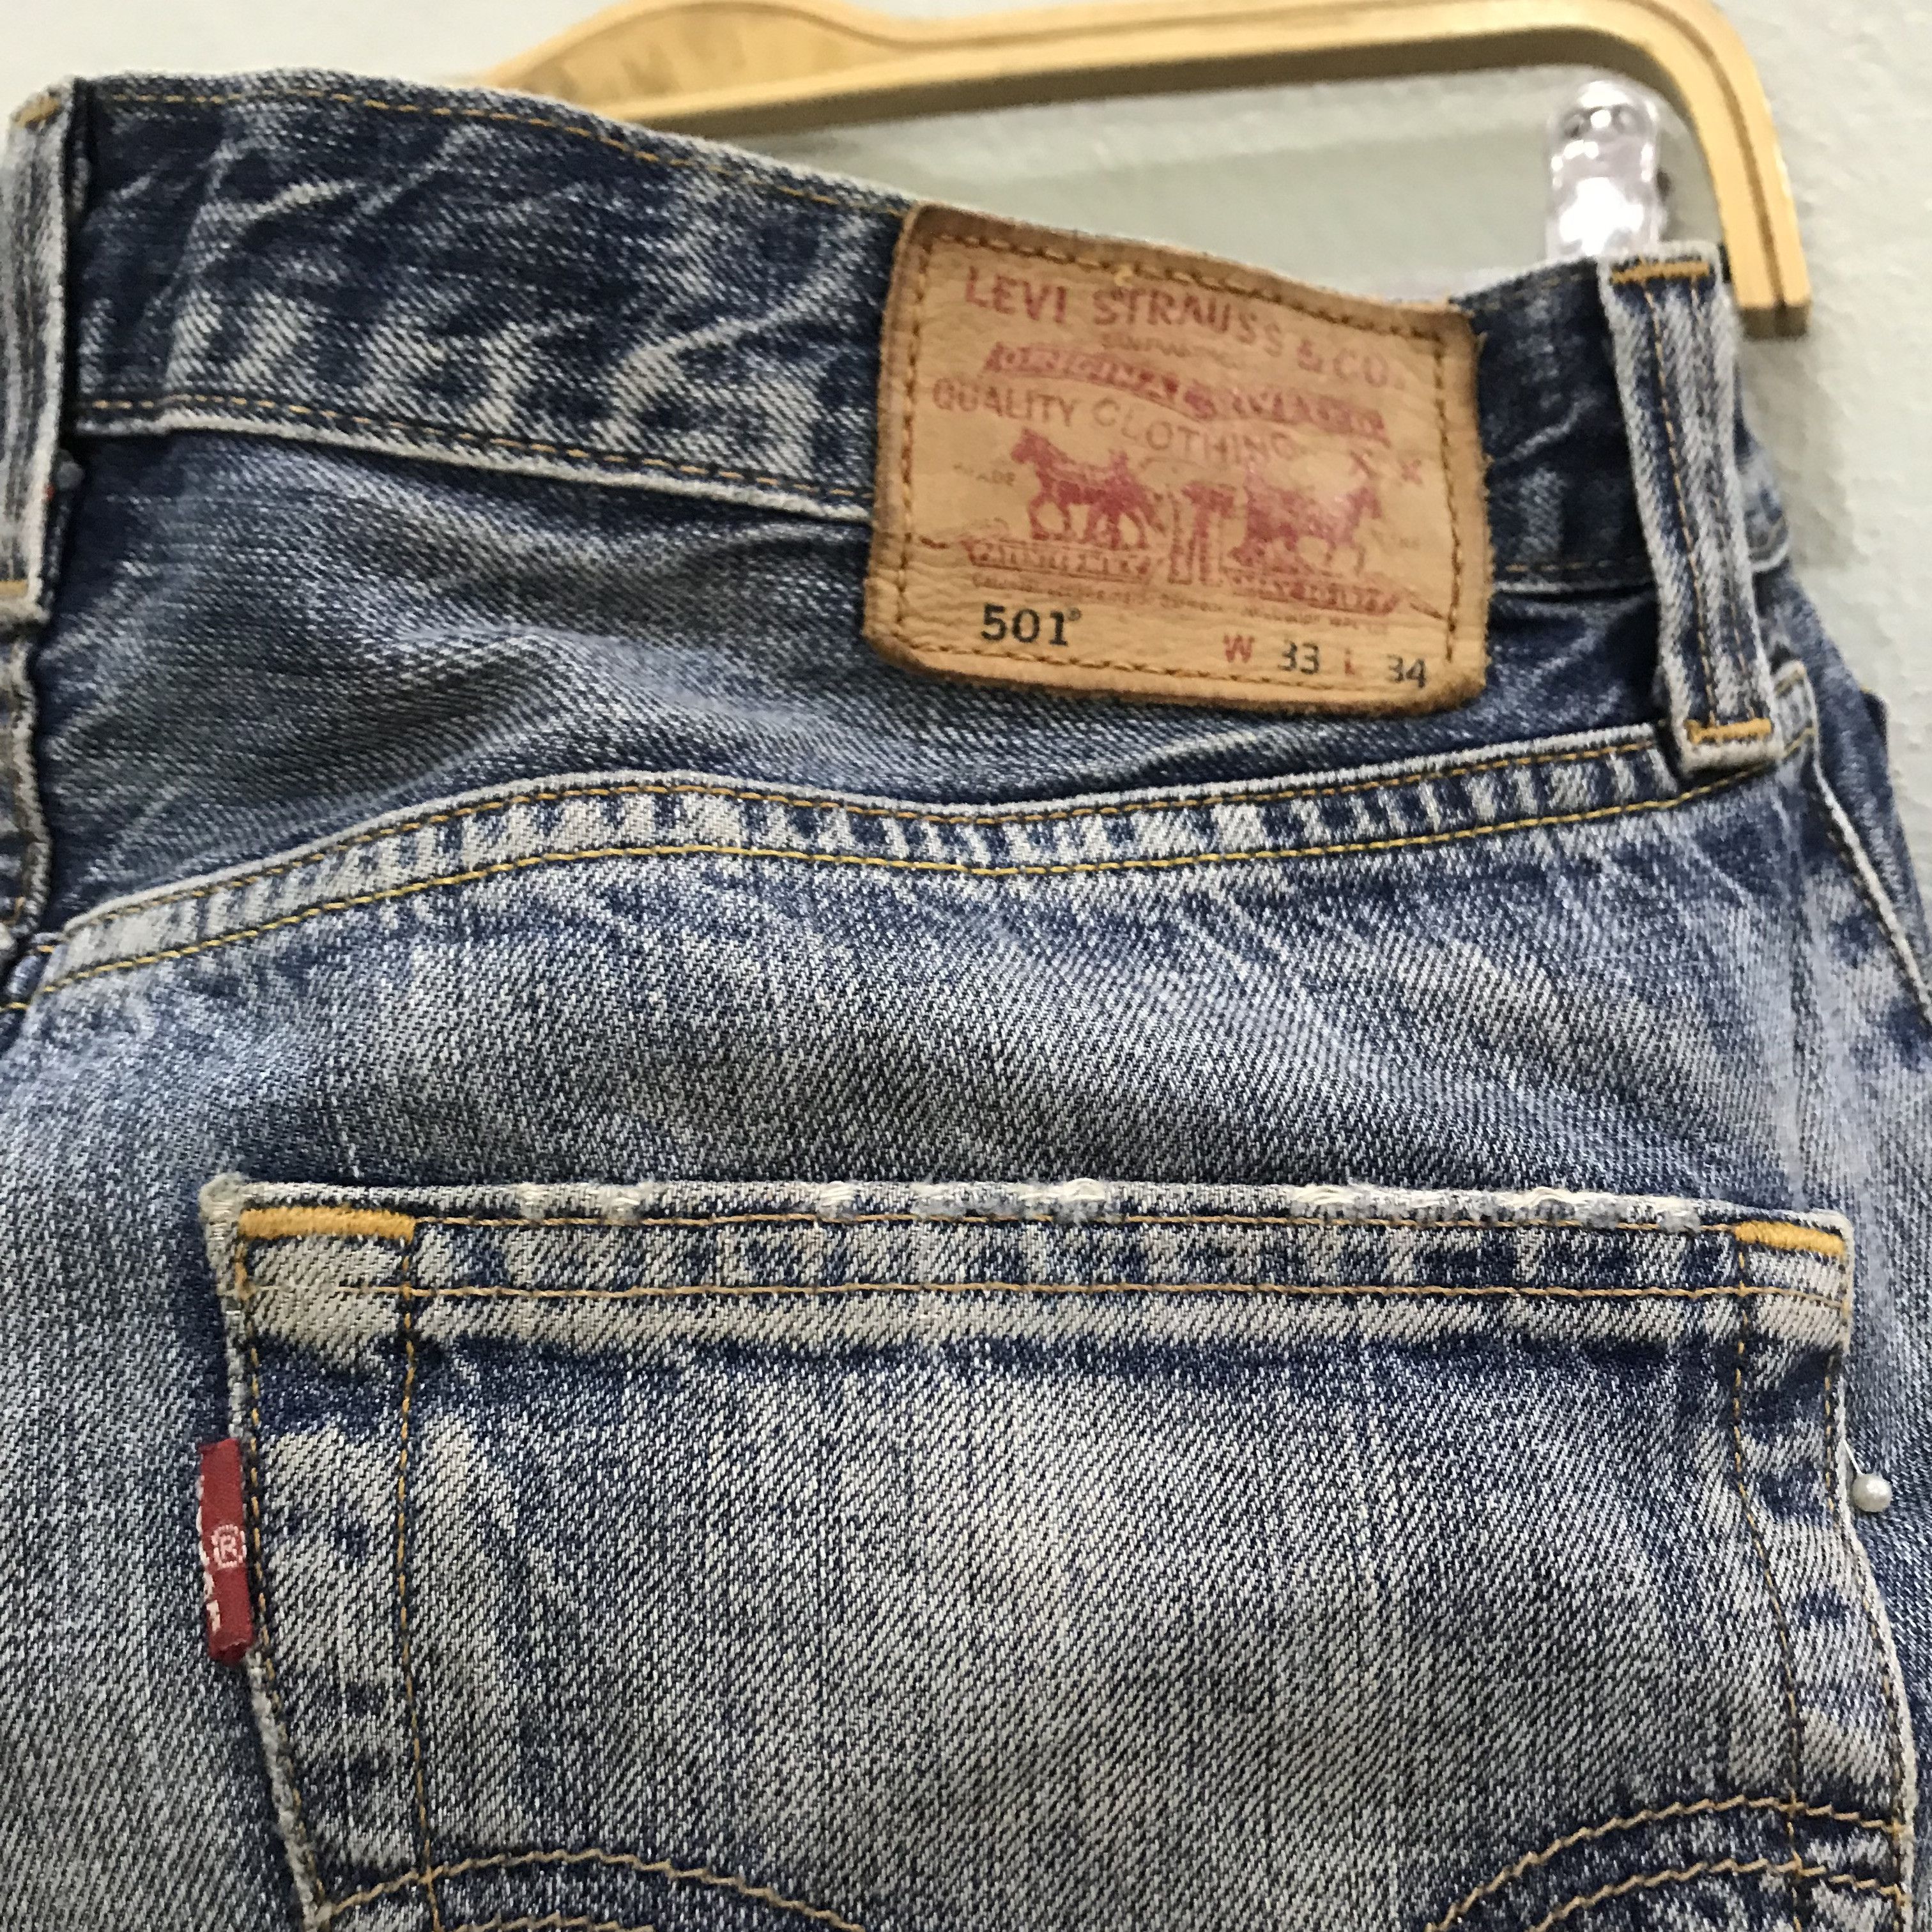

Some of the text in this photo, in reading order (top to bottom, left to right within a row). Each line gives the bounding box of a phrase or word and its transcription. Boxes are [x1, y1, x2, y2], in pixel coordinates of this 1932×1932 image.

[965, 265, 1067, 324] LEVI
[1092, 285, 1283, 357] STRAUSS
[1297, 338, 1324, 373] &
[931, 377, 1080, 427] QUALITY
[1090, 397, 1302, 471] CLOTHING
[1222, 633, 1255, 664] W
[1278, 641, 1321, 675] 33
[1386, 653, 1427, 689] 34
